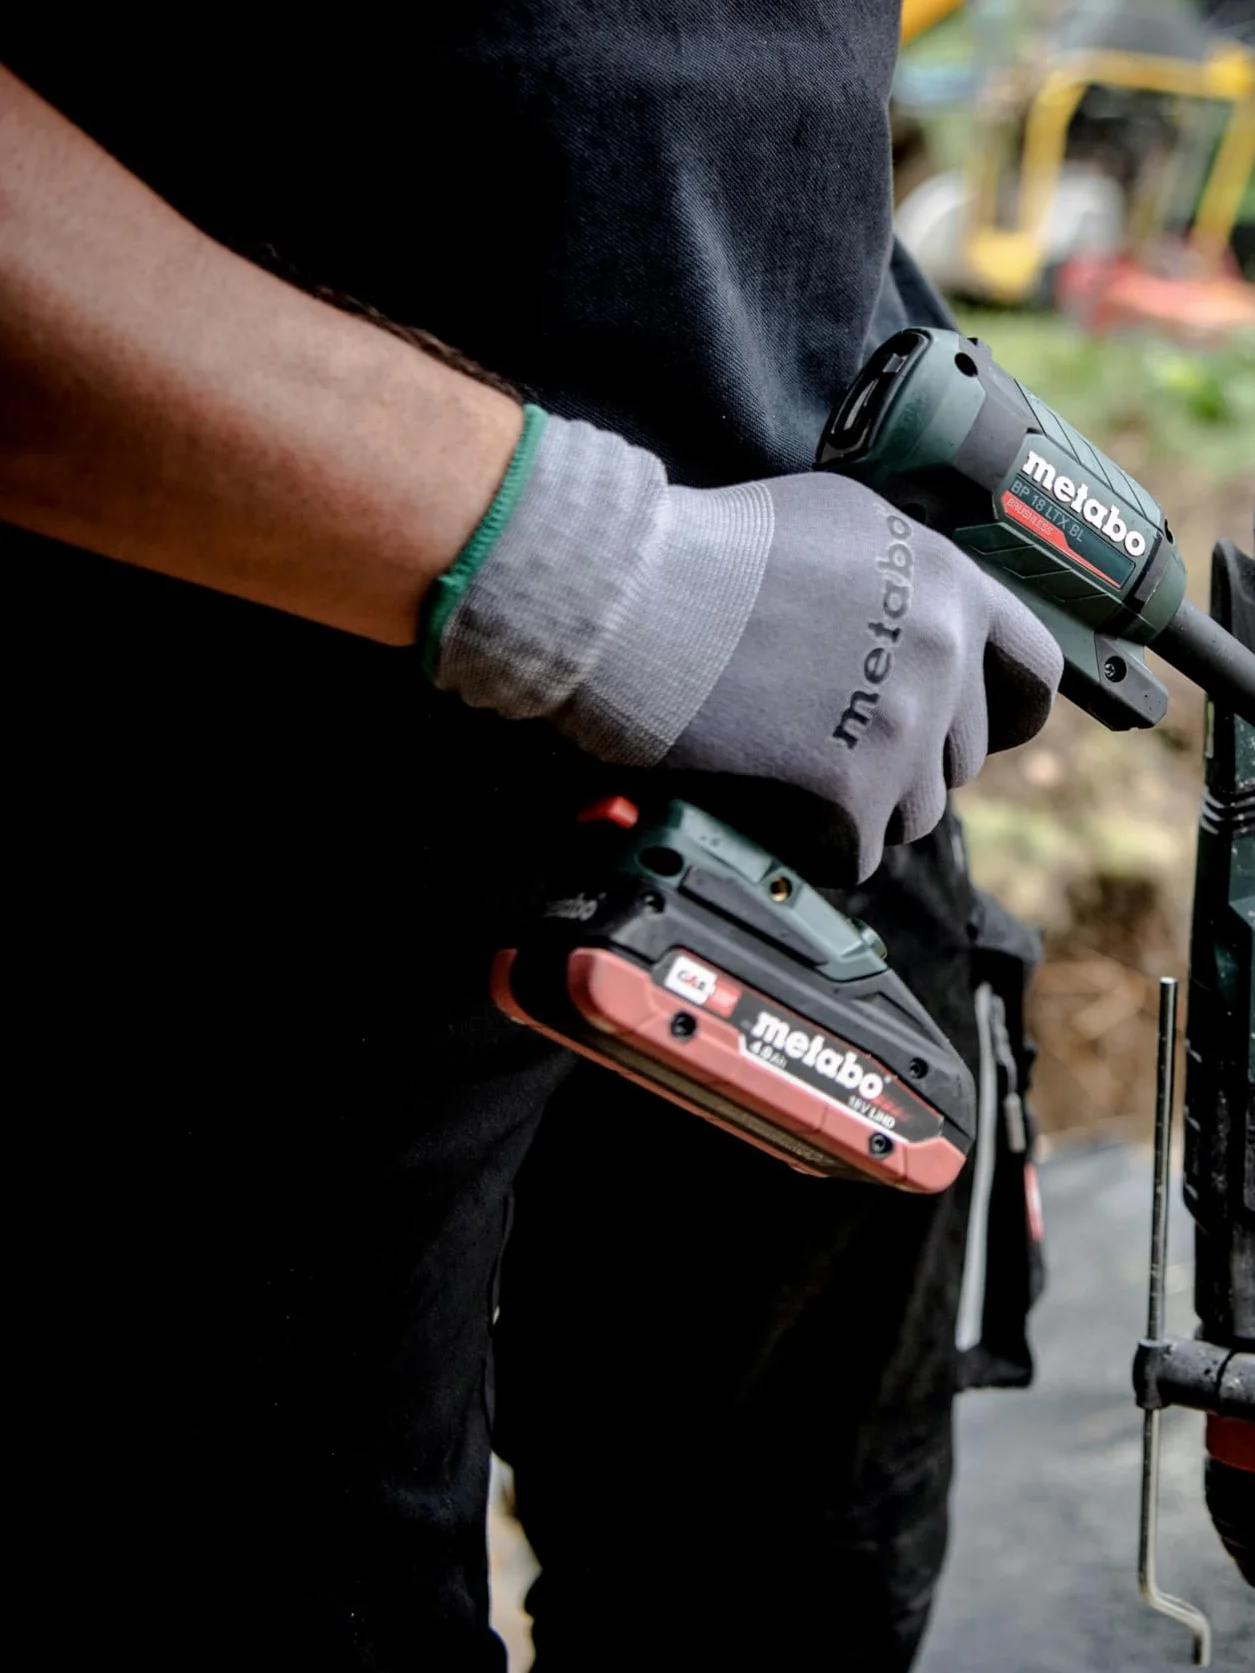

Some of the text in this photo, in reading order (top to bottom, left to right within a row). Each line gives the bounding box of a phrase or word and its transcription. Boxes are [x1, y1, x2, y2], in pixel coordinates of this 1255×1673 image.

[1006, 497, 1054, 536] BRUSHLESS
[1011, 480, 1086, 543] BP 18 LTX BL
[1022, 450, 1146, 557] metabo
[832, 515, 913, 750] metabo
[751, 1011, 884, 1101] metabo
